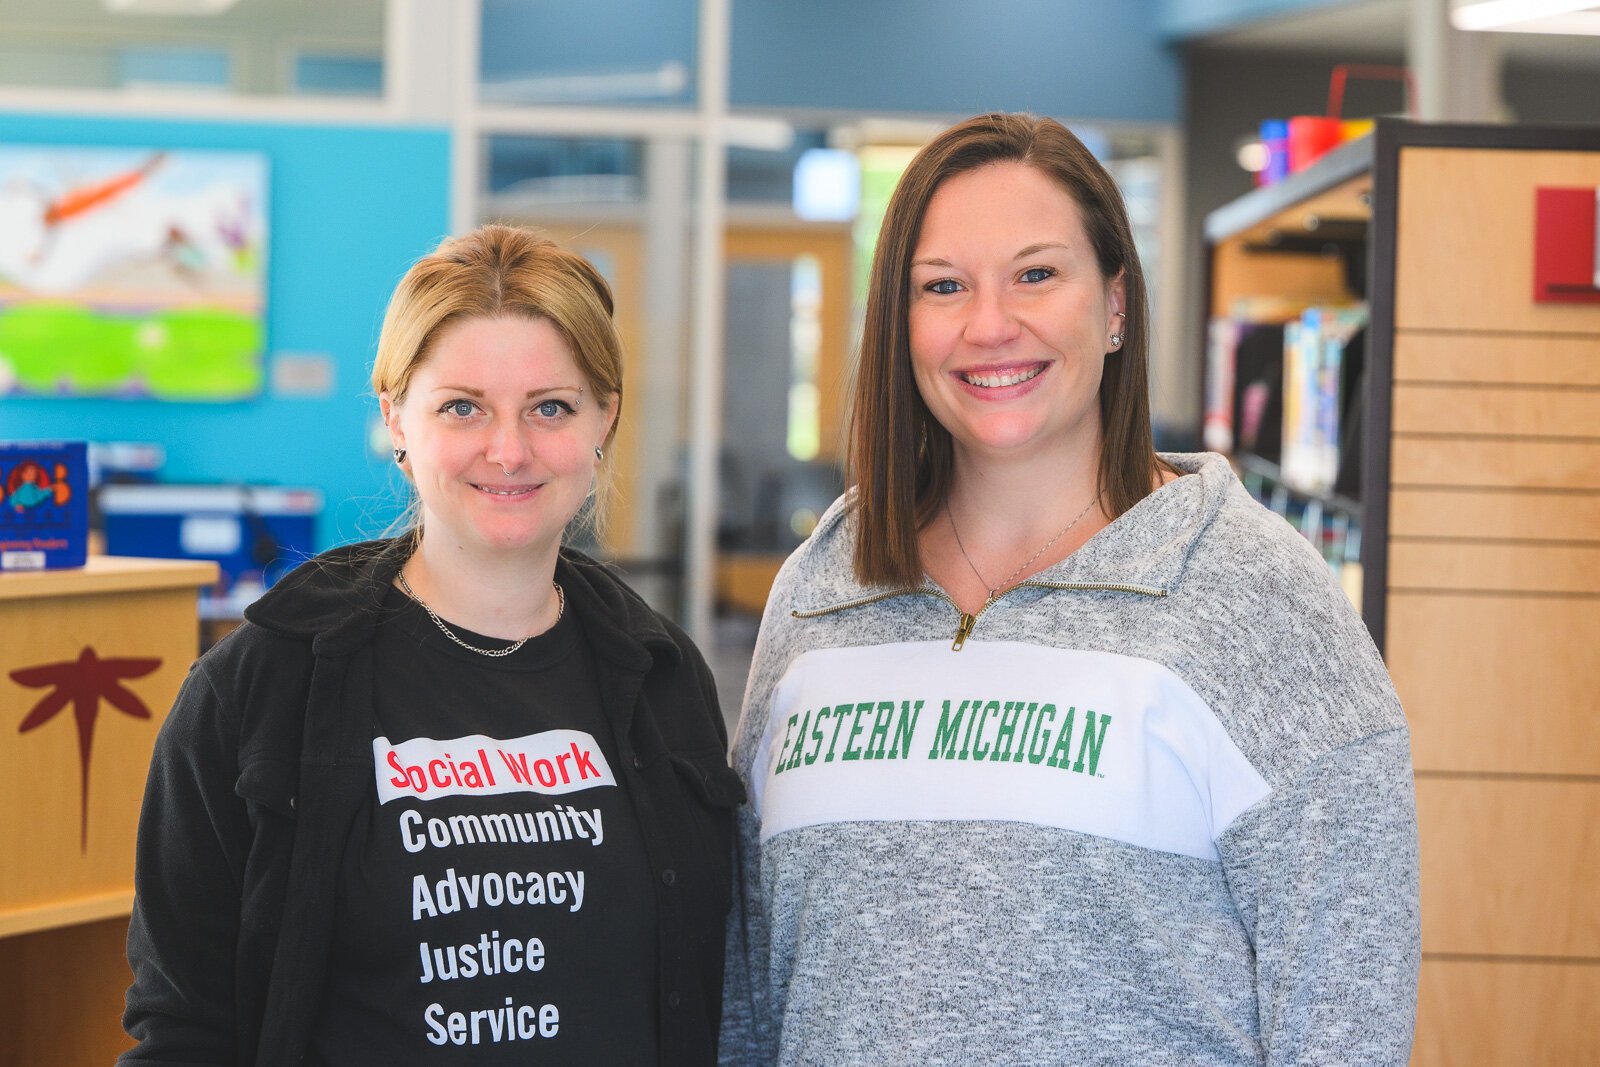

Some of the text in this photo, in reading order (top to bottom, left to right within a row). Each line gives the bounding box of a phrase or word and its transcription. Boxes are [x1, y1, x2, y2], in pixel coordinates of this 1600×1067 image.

[775, 700, 925, 776] EASTERN
[928, 700, 1112, 777] MICHIGAN
[387, 742, 601, 793] Social Work
[400, 804, 604, 853] Community
[413, 868, 585, 921] Advocacy
[420, 930, 545, 983] Justice
[424, 997, 560, 1046] Service
